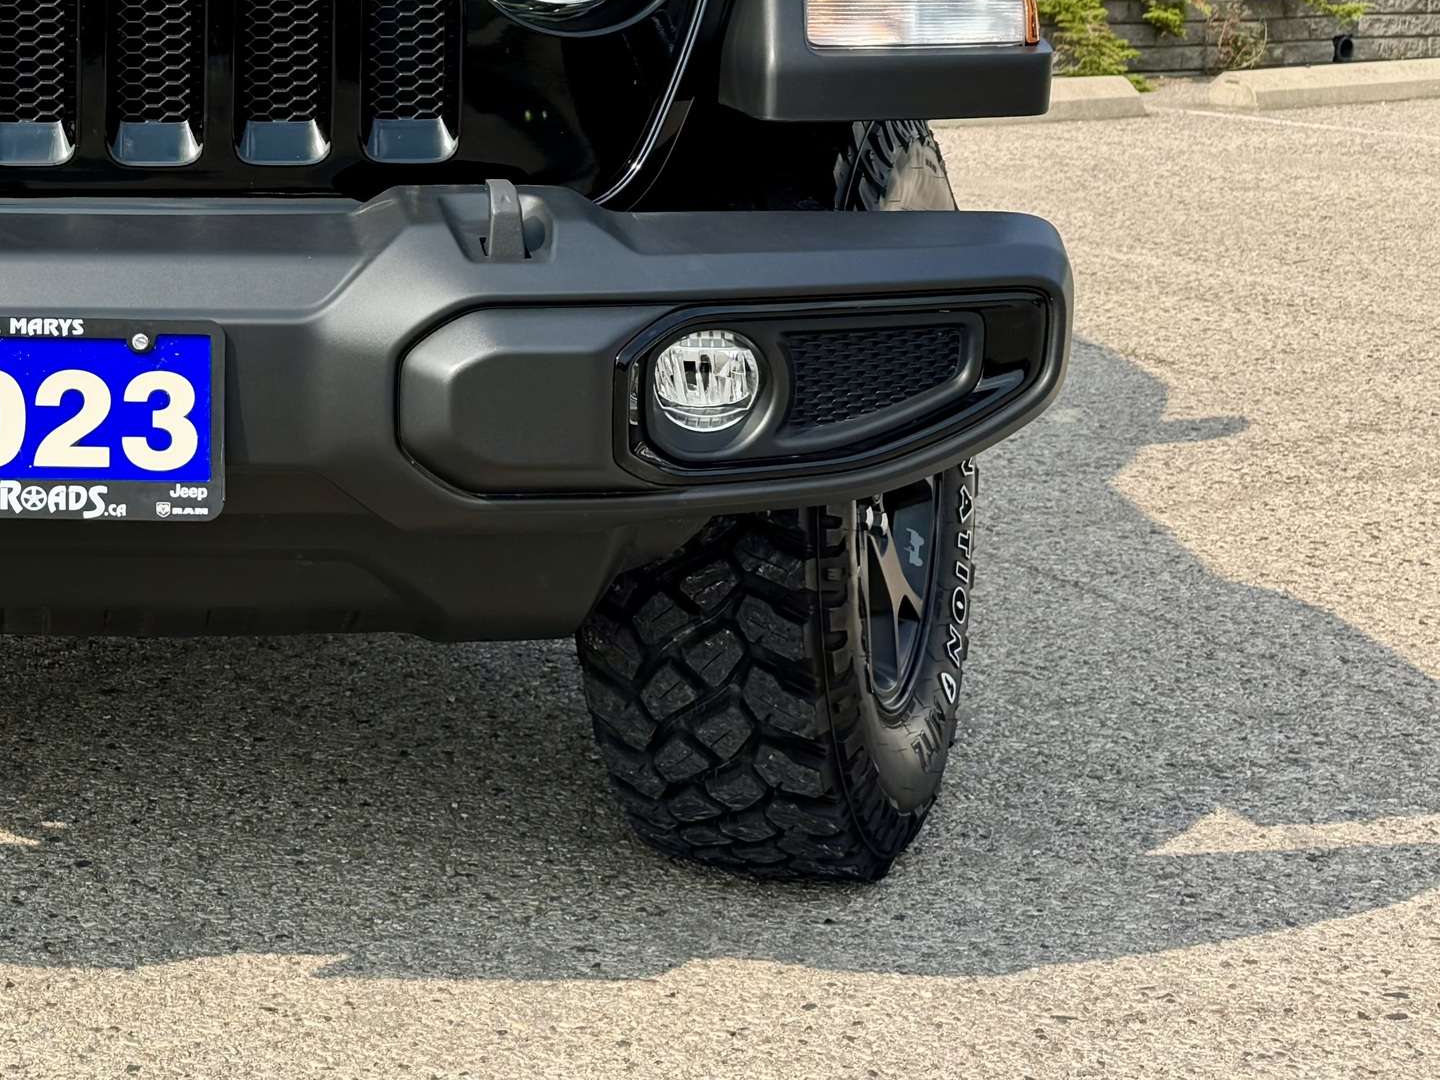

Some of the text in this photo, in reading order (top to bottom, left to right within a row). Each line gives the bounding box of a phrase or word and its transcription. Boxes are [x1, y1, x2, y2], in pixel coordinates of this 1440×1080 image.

[9, 317, 85, 337] MARYS
[169, 483, 208, 501] Jeep
[171, 507, 209, 515] RAM
